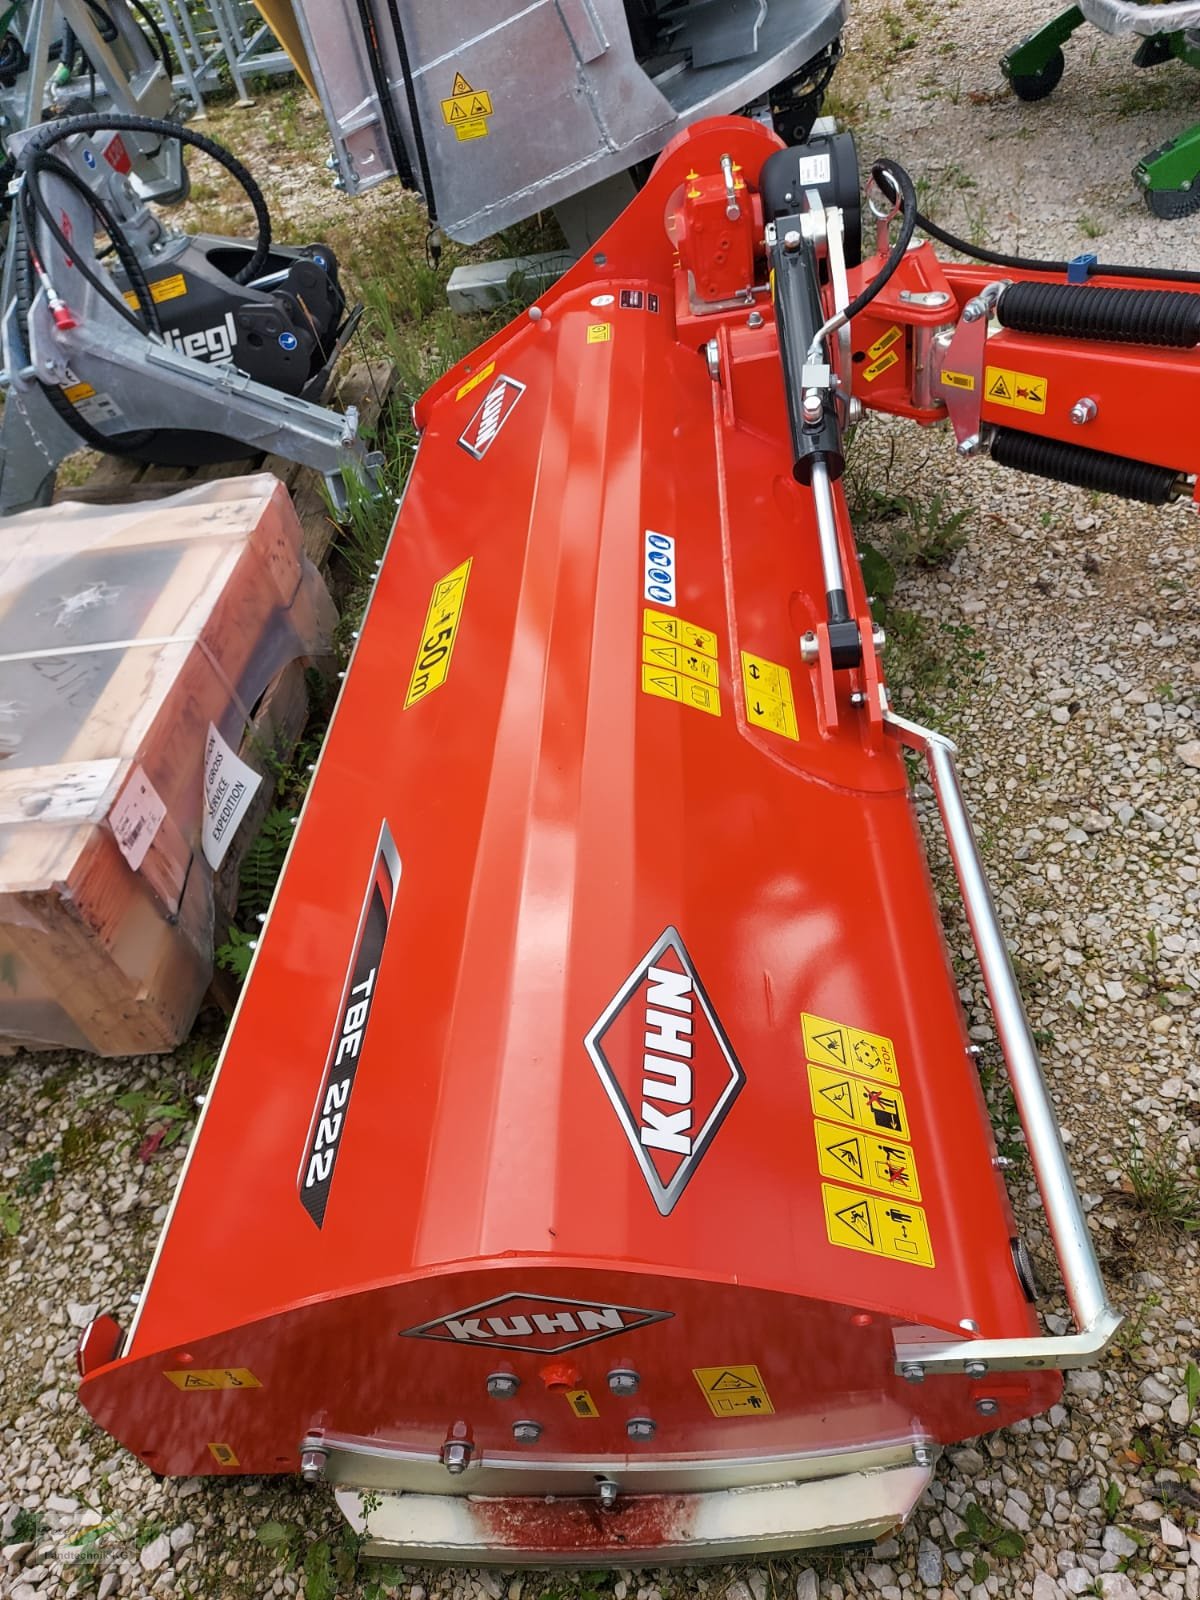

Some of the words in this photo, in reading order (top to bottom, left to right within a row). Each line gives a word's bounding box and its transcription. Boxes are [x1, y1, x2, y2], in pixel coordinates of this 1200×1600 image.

[162, 311, 238, 361] liegl
[475, 381, 507, 449] KUHN
[412, 672, 430, 697] m
[208, 753, 224, 785] GROSS
[208, 776, 229, 818] SERVICE
[212, 780, 245, 841] EXPEDITION
[335, 967, 376, 1067] TBE
[641, 966, 693, 1156] KUHN
[881, 1046, 893, 1073] STOP
[305, 1078, 351, 1188] 222
[445, 1309, 625, 1339] KUHN
